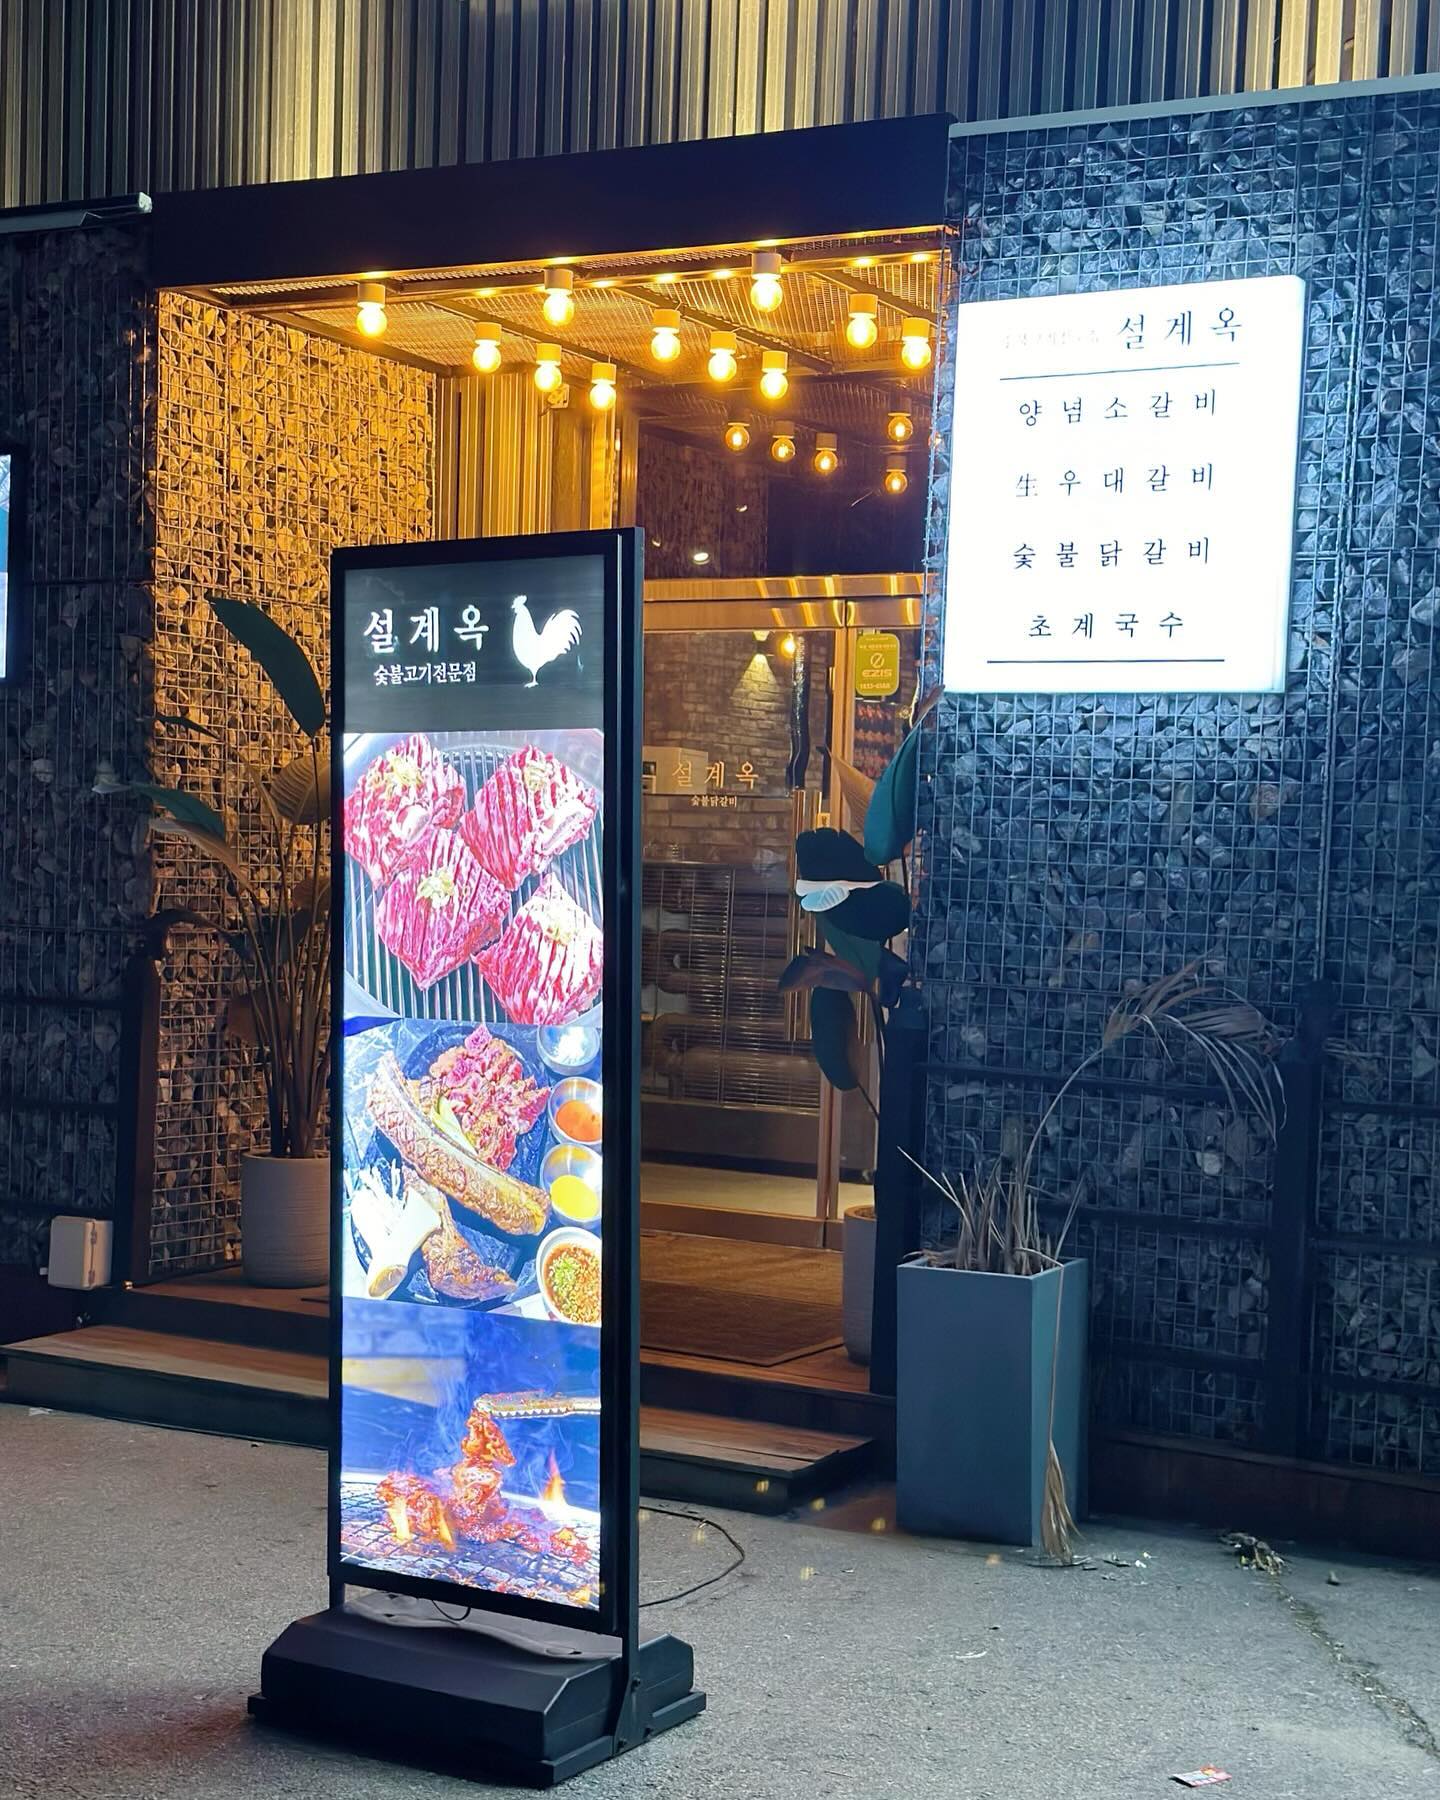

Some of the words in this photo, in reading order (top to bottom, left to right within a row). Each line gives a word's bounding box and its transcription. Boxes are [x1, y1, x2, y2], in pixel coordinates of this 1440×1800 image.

[1118, 306, 1243, 350] 설계옥
[1019, 388, 1216, 427] 양념소갈비
[1013, 537, 1209, 570] 숯불닭갈비
[363, 604, 490, 654] 설계옥
[1028, 611, 1184, 639] 초계국수
[373, 660, 477, 687] 숯불고기전문점
[671, 760, 760, 790] 설계옥
